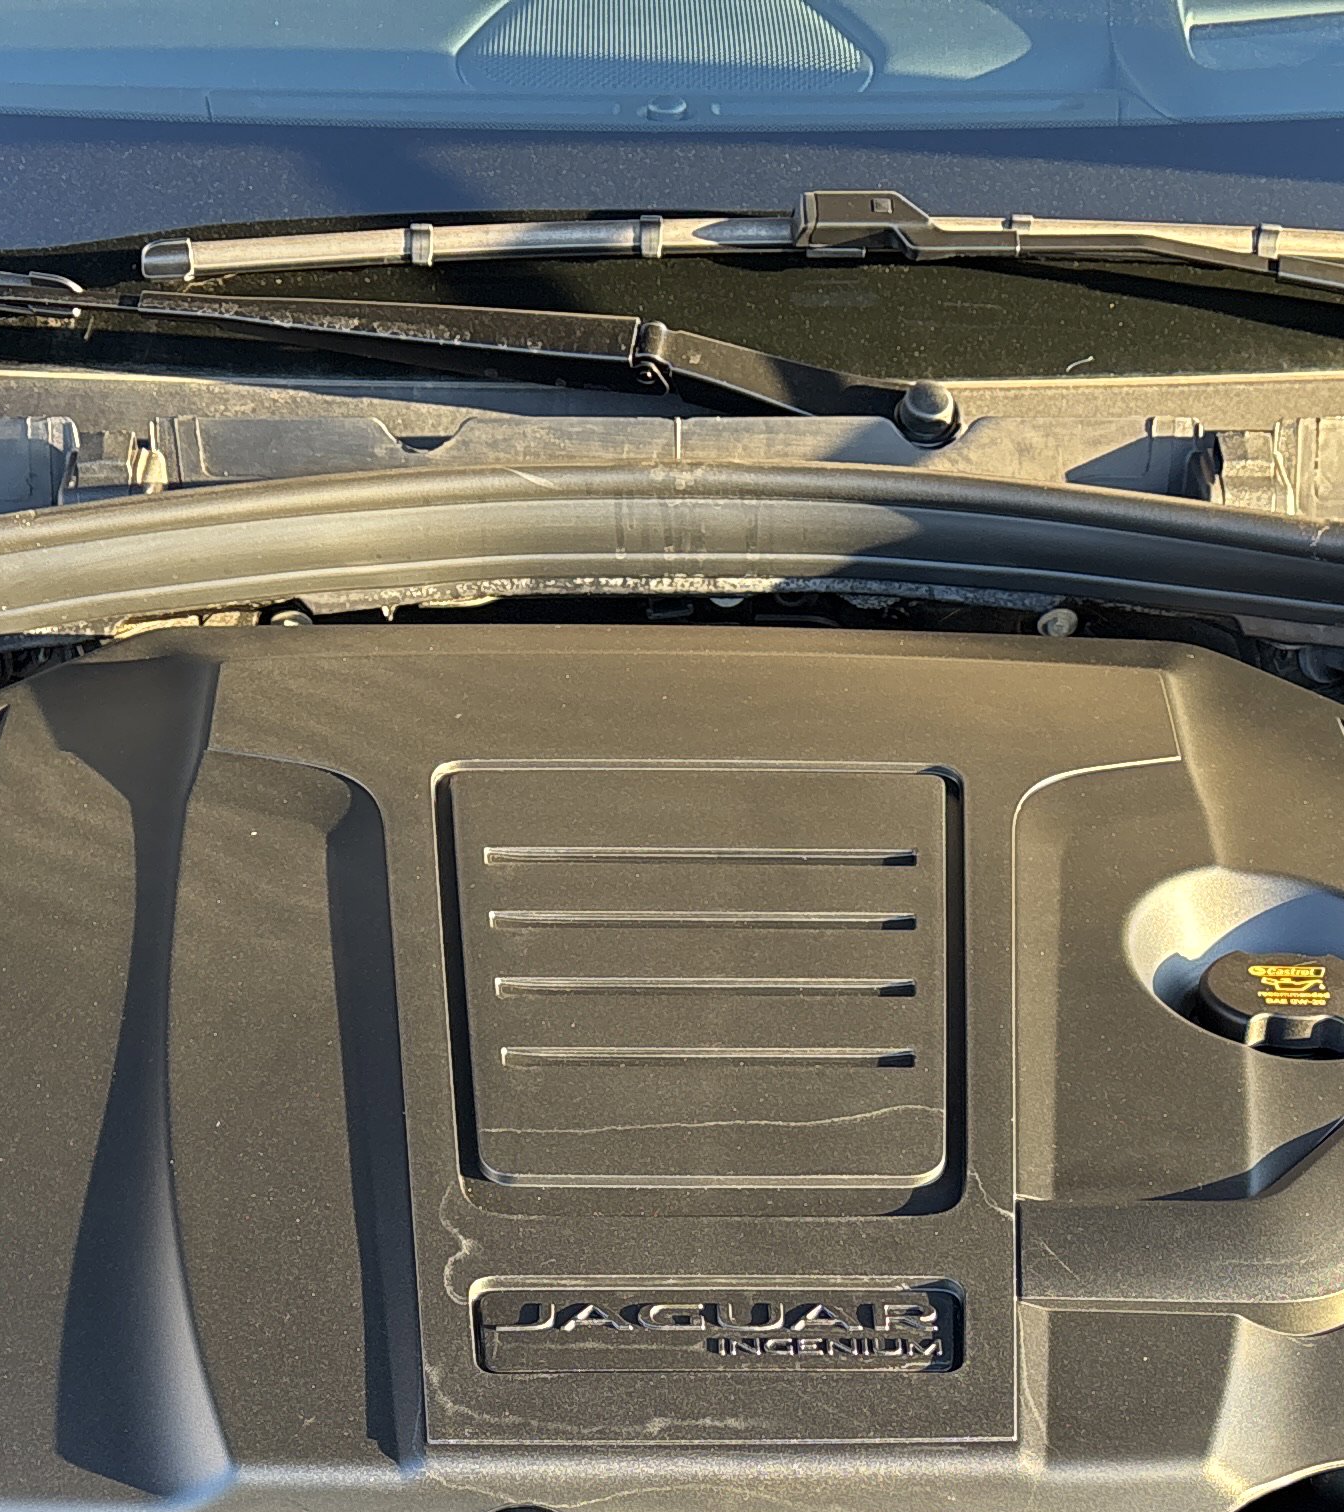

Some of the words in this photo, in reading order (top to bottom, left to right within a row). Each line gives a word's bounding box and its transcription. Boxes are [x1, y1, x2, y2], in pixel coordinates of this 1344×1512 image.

[1266, 967, 1315, 977] Castrol
[1257, 991, 1331, 999] recommended
[494, 1302, 939, 1332] JAGUAR
[716, 1337, 943, 1356] INGENIUM
